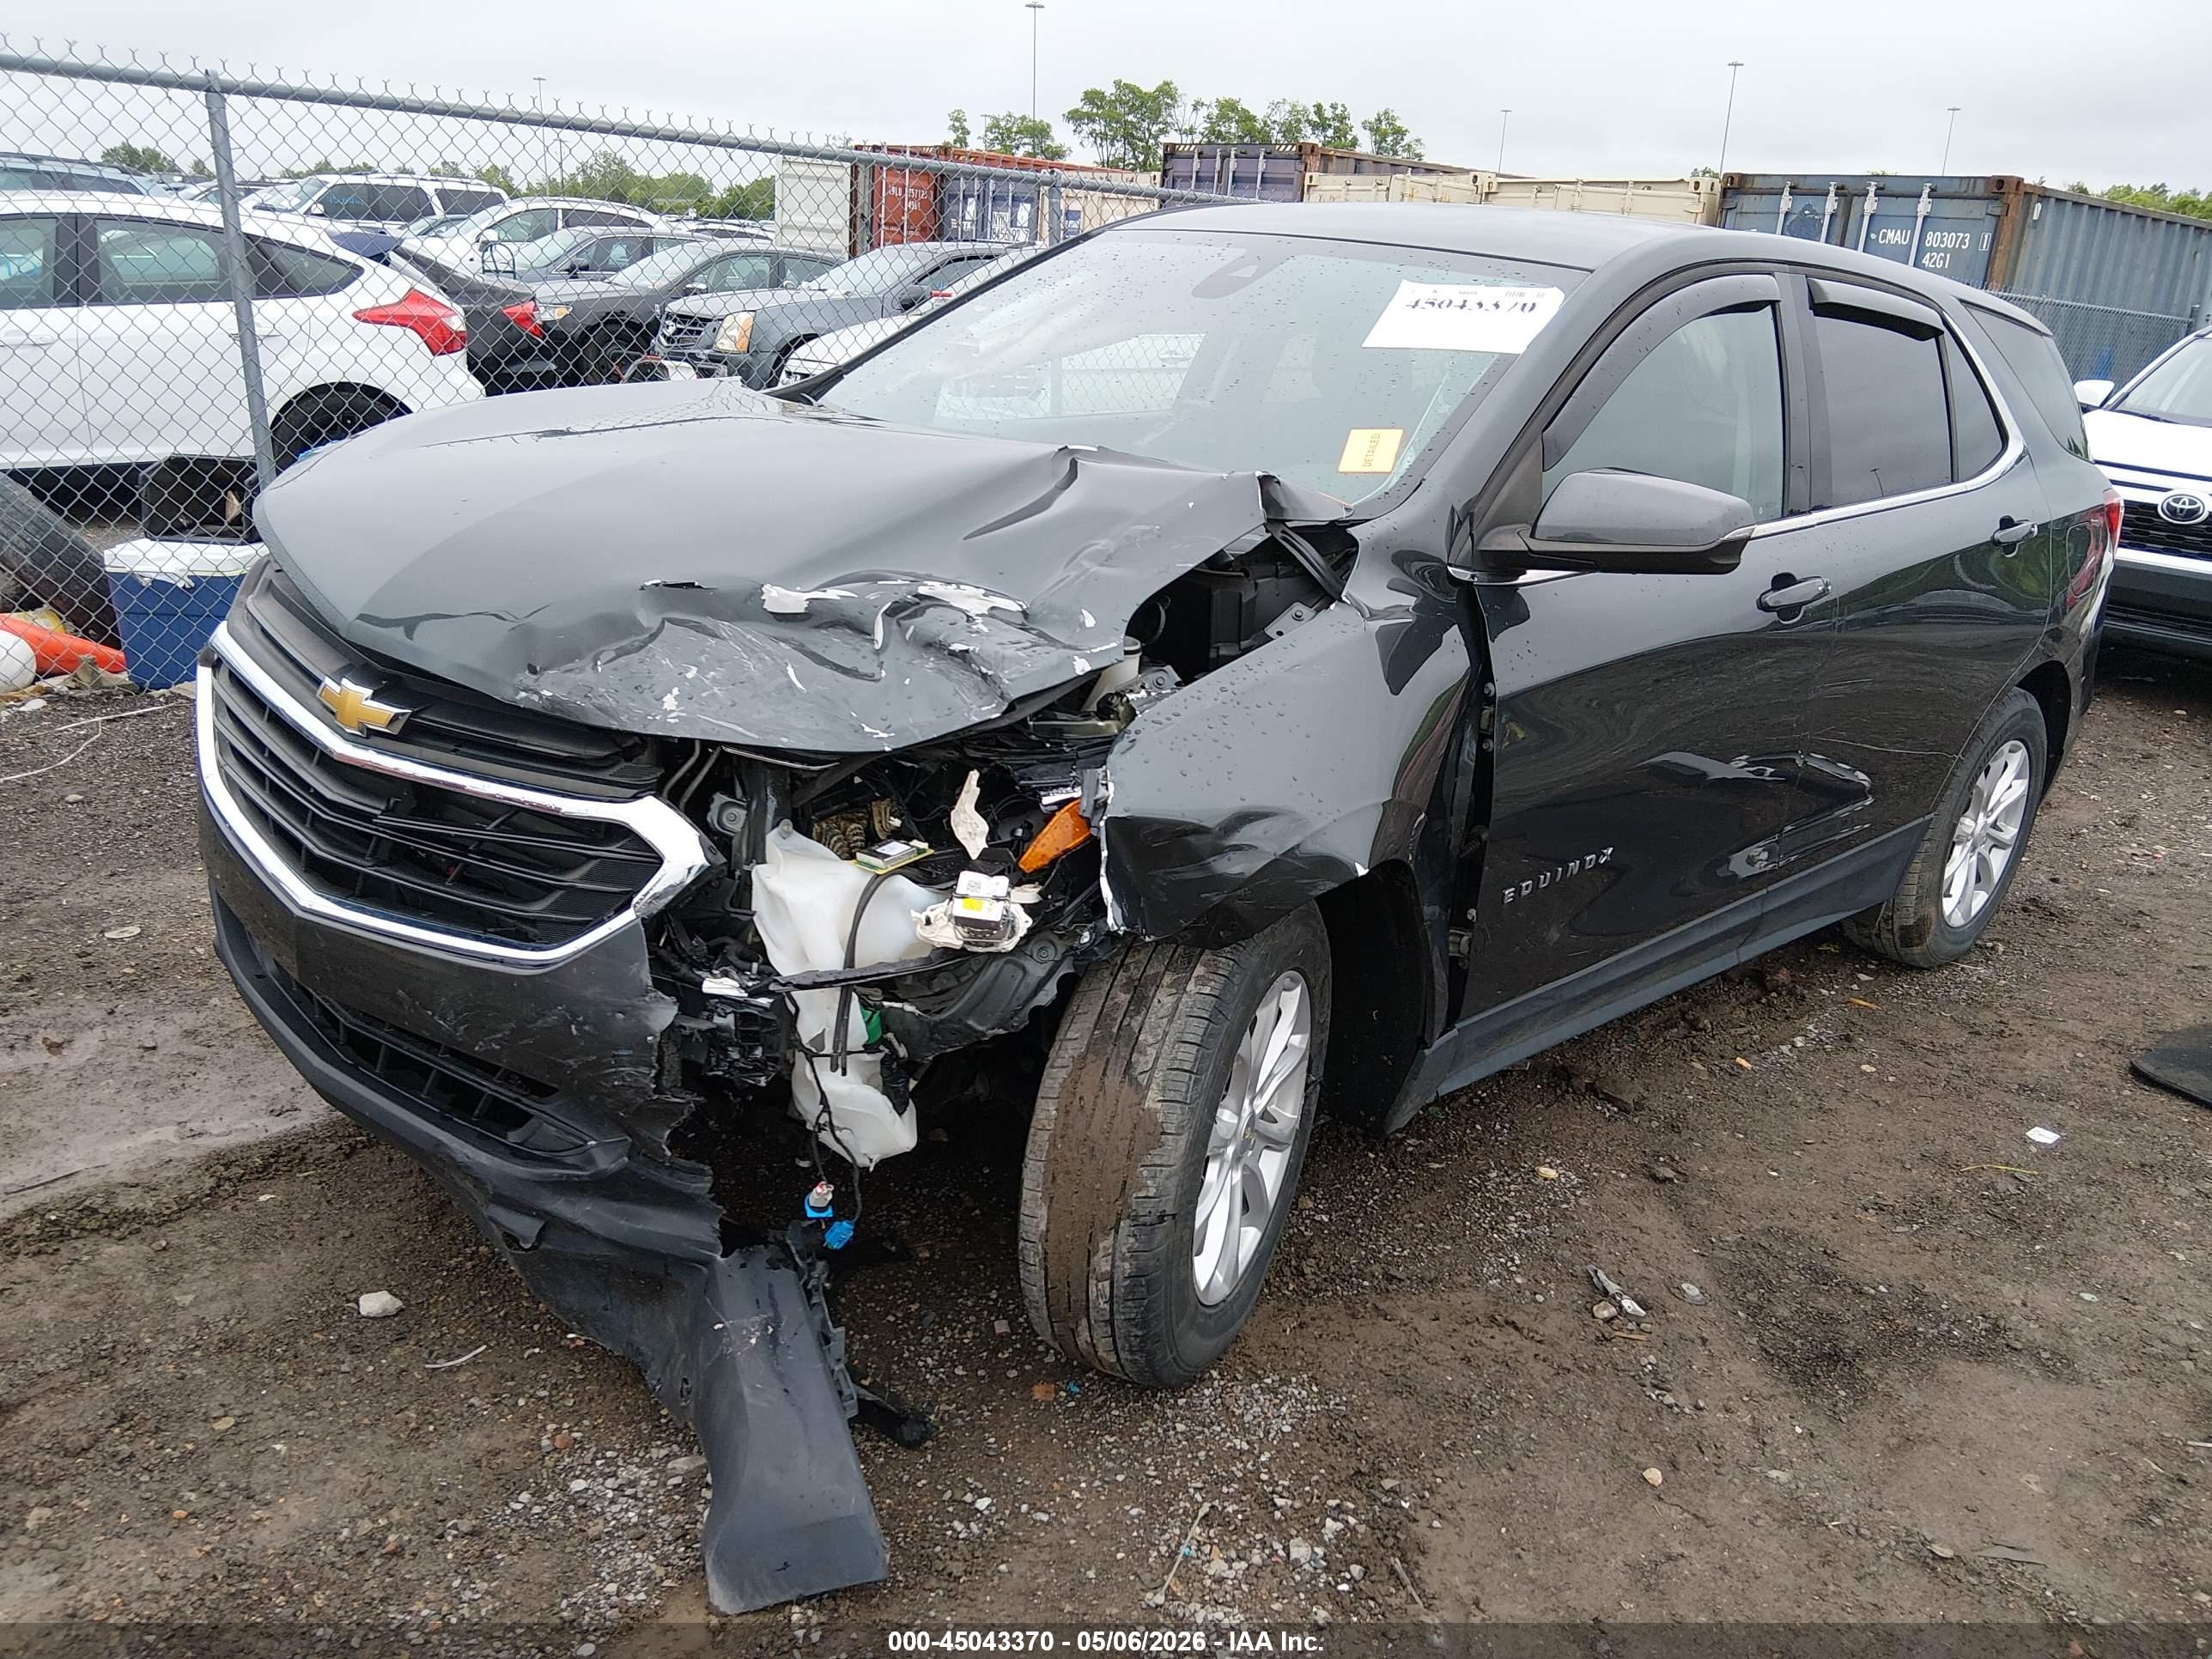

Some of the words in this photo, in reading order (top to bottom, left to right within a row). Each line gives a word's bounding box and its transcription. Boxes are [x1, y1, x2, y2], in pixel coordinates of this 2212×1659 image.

[1878, 228, 1911, 246] CMAU
[1924, 232, 1970, 249] 803073
[1921, 252, 1951, 269] 42G1
[1362, 433, 1381, 467] DETAILED
[1503, 847, 1614, 904] EQUINOX
